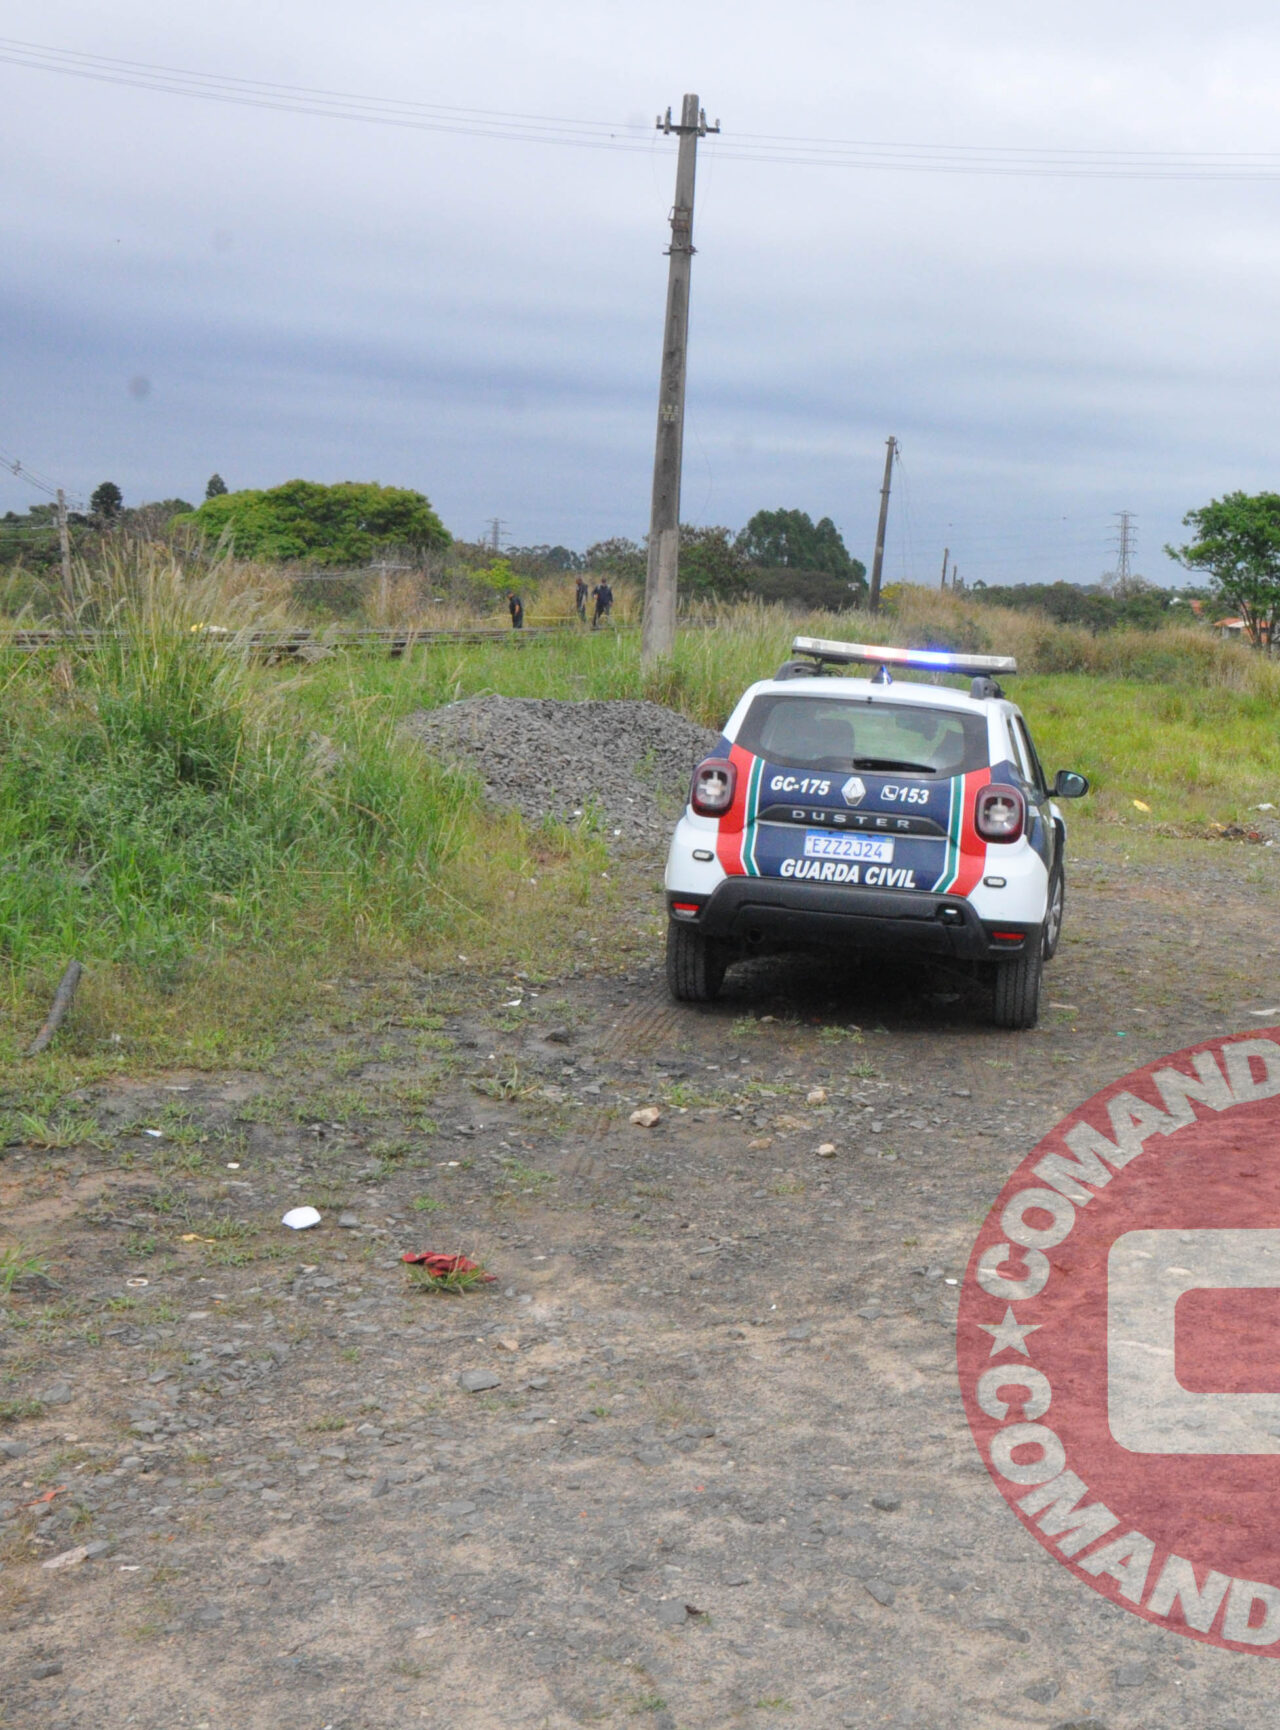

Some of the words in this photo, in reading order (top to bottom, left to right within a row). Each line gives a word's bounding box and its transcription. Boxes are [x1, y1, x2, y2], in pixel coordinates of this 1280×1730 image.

[770, 775, 831, 796] GC-175
[899, 787, 929, 804] 153
[791, 810, 910, 828] DUSTER
[811, 838, 883, 859] EZZ2J24
[780, 858, 859, 883] GUARDA
[864, 866, 916, 888] CIVIL
